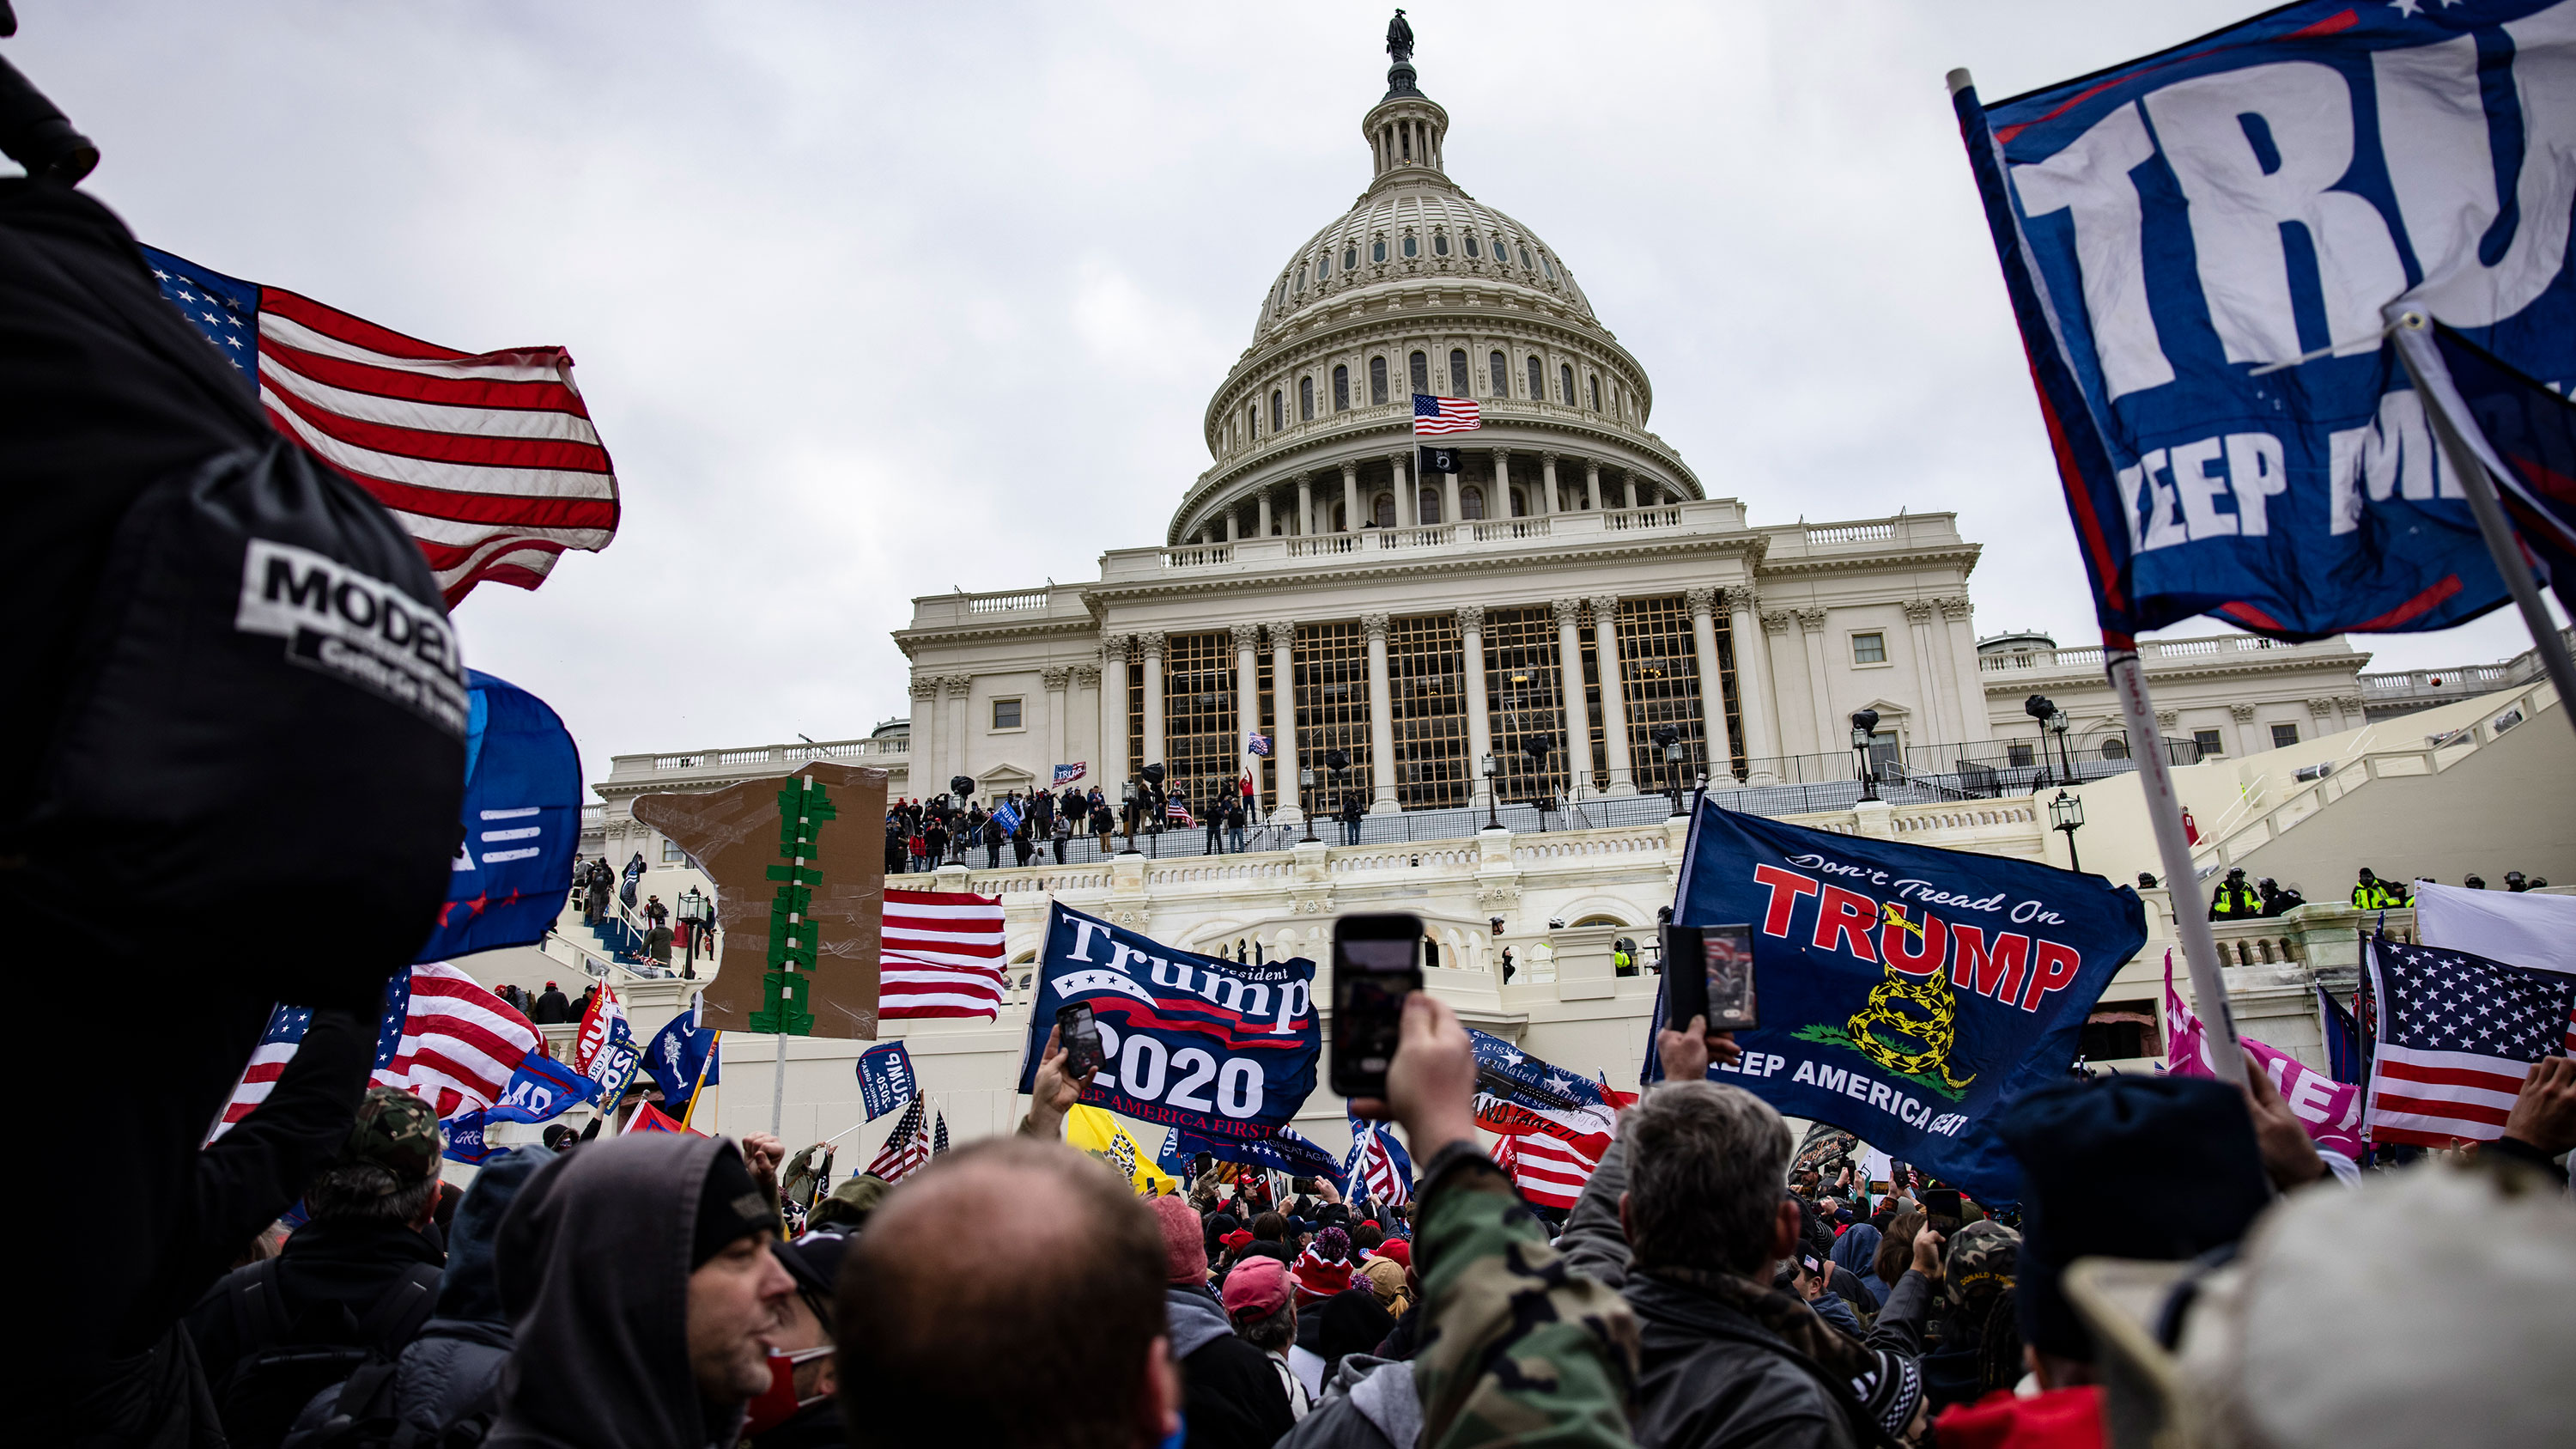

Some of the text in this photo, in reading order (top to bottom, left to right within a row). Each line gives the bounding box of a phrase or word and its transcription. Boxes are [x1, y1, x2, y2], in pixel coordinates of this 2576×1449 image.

[1784, 853, 2065, 926] Don't Tread On
[1753, 862, 2081, 1013] TRUMP
[1062, 913, 1309, 1034] Trump
[1082, 1087, 1105, 1101] EP
[1110, 1095, 1208, 1129] AMERICA
[1512, 1107, 1559, 1133] TAKE
[1792, 1060, 1932, 1130] AMERICA
[1268, 1139, 1303, 1157] GREAT
